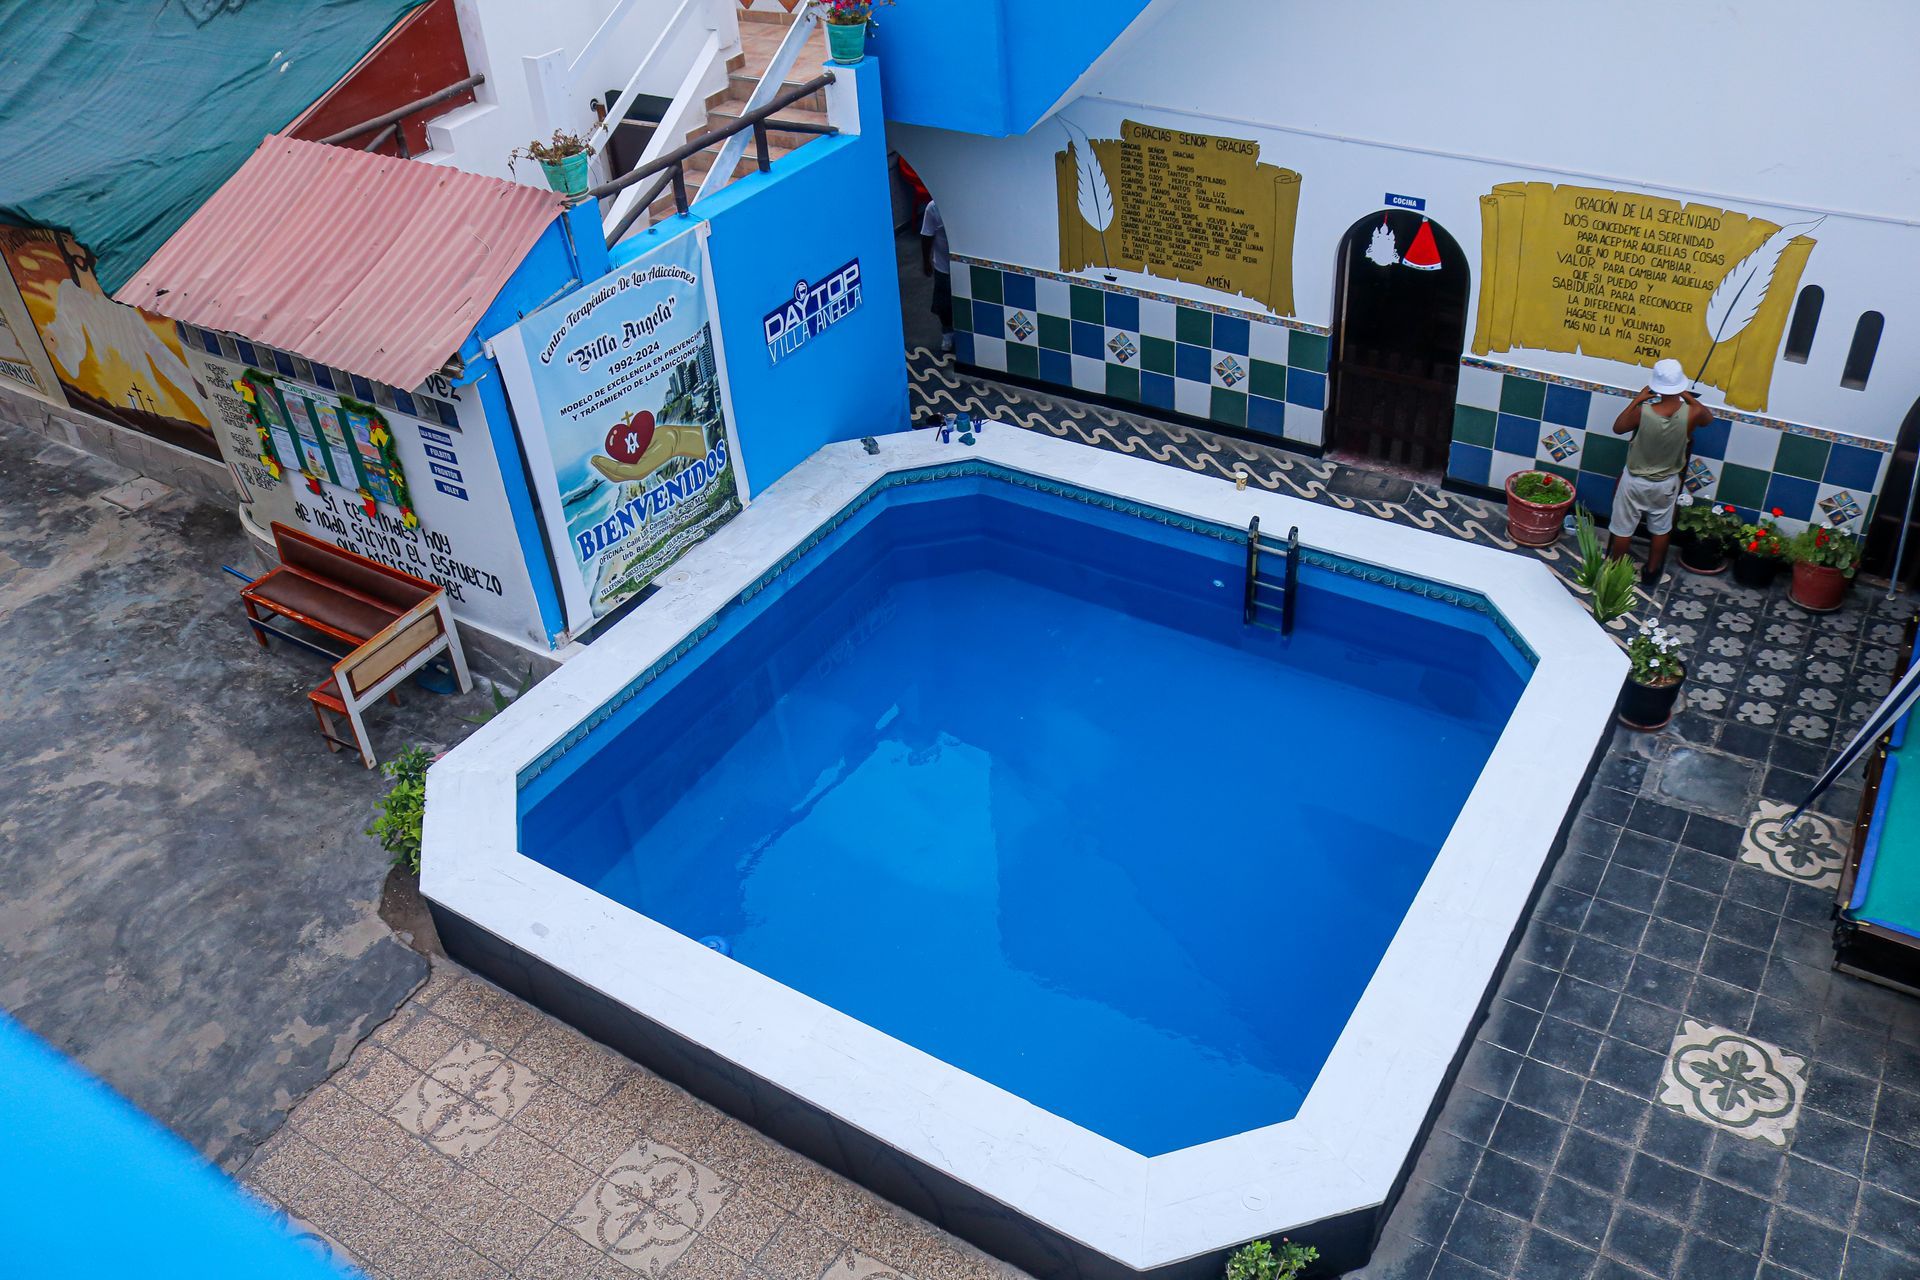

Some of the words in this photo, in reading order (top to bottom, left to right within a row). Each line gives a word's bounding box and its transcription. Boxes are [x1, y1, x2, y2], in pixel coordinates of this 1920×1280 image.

[1134, 126, 1172, 142] GRACIAS
[1216, 139, 1253, 155] GRACIAS
[1121, 162, 1143, 171] CUANDO
[1196, 176, 1226, 185] MUTILADOS
[1149, 161, 1169, 169] BRAZOS
[1176, 165, 1194, 173] SANOS
[1121, 176, 1143, 184] CUANDO
[1168, 184, 1190, 192] TANTOS
[1172, 178, 1202, 188] PERFECTOS
[1121, 189, 1142, 197] CUANDO
[1169, 197, 1190, 205] TANTOS
[1216, 205, 1244, 215] MENDIGAN
[1132, 198, 1167, 208] MARAVILLOSO
[1152, 188, 1170, 196] MANOS
[1195, 195, 1226, 205] TRABAJAN
[1393, 197, 1417, 206] COCINA
[1575, 197, 1618, 214] ORACIÓN
[1623, 203, 1636, 218] DE
[1640, 206, 1652, 220] LA
[1658, 209, 1720, 231] SERENIDAD
[1564, 213, 1588, 228] DIOS
[1593, 220, 1641, 237] CONCEDEME
[1644, 229, 1655, 239] LA
[1659, 230, 1714, 249] SERENIDAD
[1132, 242, 1149, 250] TANTO
[1173, 250, 1202, 259] AGRADECER
[1576, 244, 1592, 255] QUE
[1596, 248, 1609, 258] NO
[1614, 251, 1645, 265] PUEDO
[1577, 231, 1598, 243] PARA
[1641, 242, 1687, 259] AQUELLAS
[1693, 250, 1725, 265] COSAS
[1172, 262, 1194, 271] GRACIAS
[1557, 251, 1595, 269] VALOR
[1603, 262, 1624, 275] PARA
[1629, 267, 1667, 282] CAMBIAR
[1672, 274, 1714, 290] AQUELLAS
[1206, 275, 1230, 289] AMÉN
[1573, 270, 1589, 281] QUE
[1593, 273, 1602, 283] SI
[1607, 276, 1638, 290] PUEDO
[1648, 283, 1654, 292] Y
[765, 264, 860, 343] DAYTOP
[1568, 295, 1579, 305] LA
[1611, 289, 1634, 302] PARA
[1640, 294, 1693, 313] RECONOCER
[541, 327, 566, 364] Centro
[566, 285, 616, 327] Terapéutico
[618, 278, 630, 290] De
[632, 272, 646, 286] Las
[648, 266, 695, 284] Adicciones
[768, 321, 811, 363] VILLA
[817, 286, 862, 334] ANGELA
[1583, 323, 1596, 333] NO
[1600, 326, 1610, 336] LA
[1616, 329, 1631, 340] MÍA
[608, 341, 660, 375] 1992-2024
[560, 394, 592, 416] MODELO
[594, 388, 605, 398] DE
[607, 362, 652, 391] EXCELENCIA
[653, 356, 663, 365] EN
[580, 385, 632, 417] TRATAMIENTO
[634, 378, 644, 388] DE
[645, 370, 659, 381] LAS
[660, 345, 699, 373] ADICCIONES
[443, 484, 460, 495] VOLEY
[577, 440, 725, 562] BIENVENIDOS
[344, 499, 360, 521] te
[423, 529, 450, 555] hoy
[295, 501, 310, 523] de
[313, 506, 348, 537] nada
[351, 520, 401, 558] sirvio
[431, 553, 503, 596] esfuerzo
[600, 545, 625, 565] OFICINA:
[626, 537, 640, 548] Calle
[623, 552, 635, 560] Urb.
[637, 542, 650, 553] Bello
